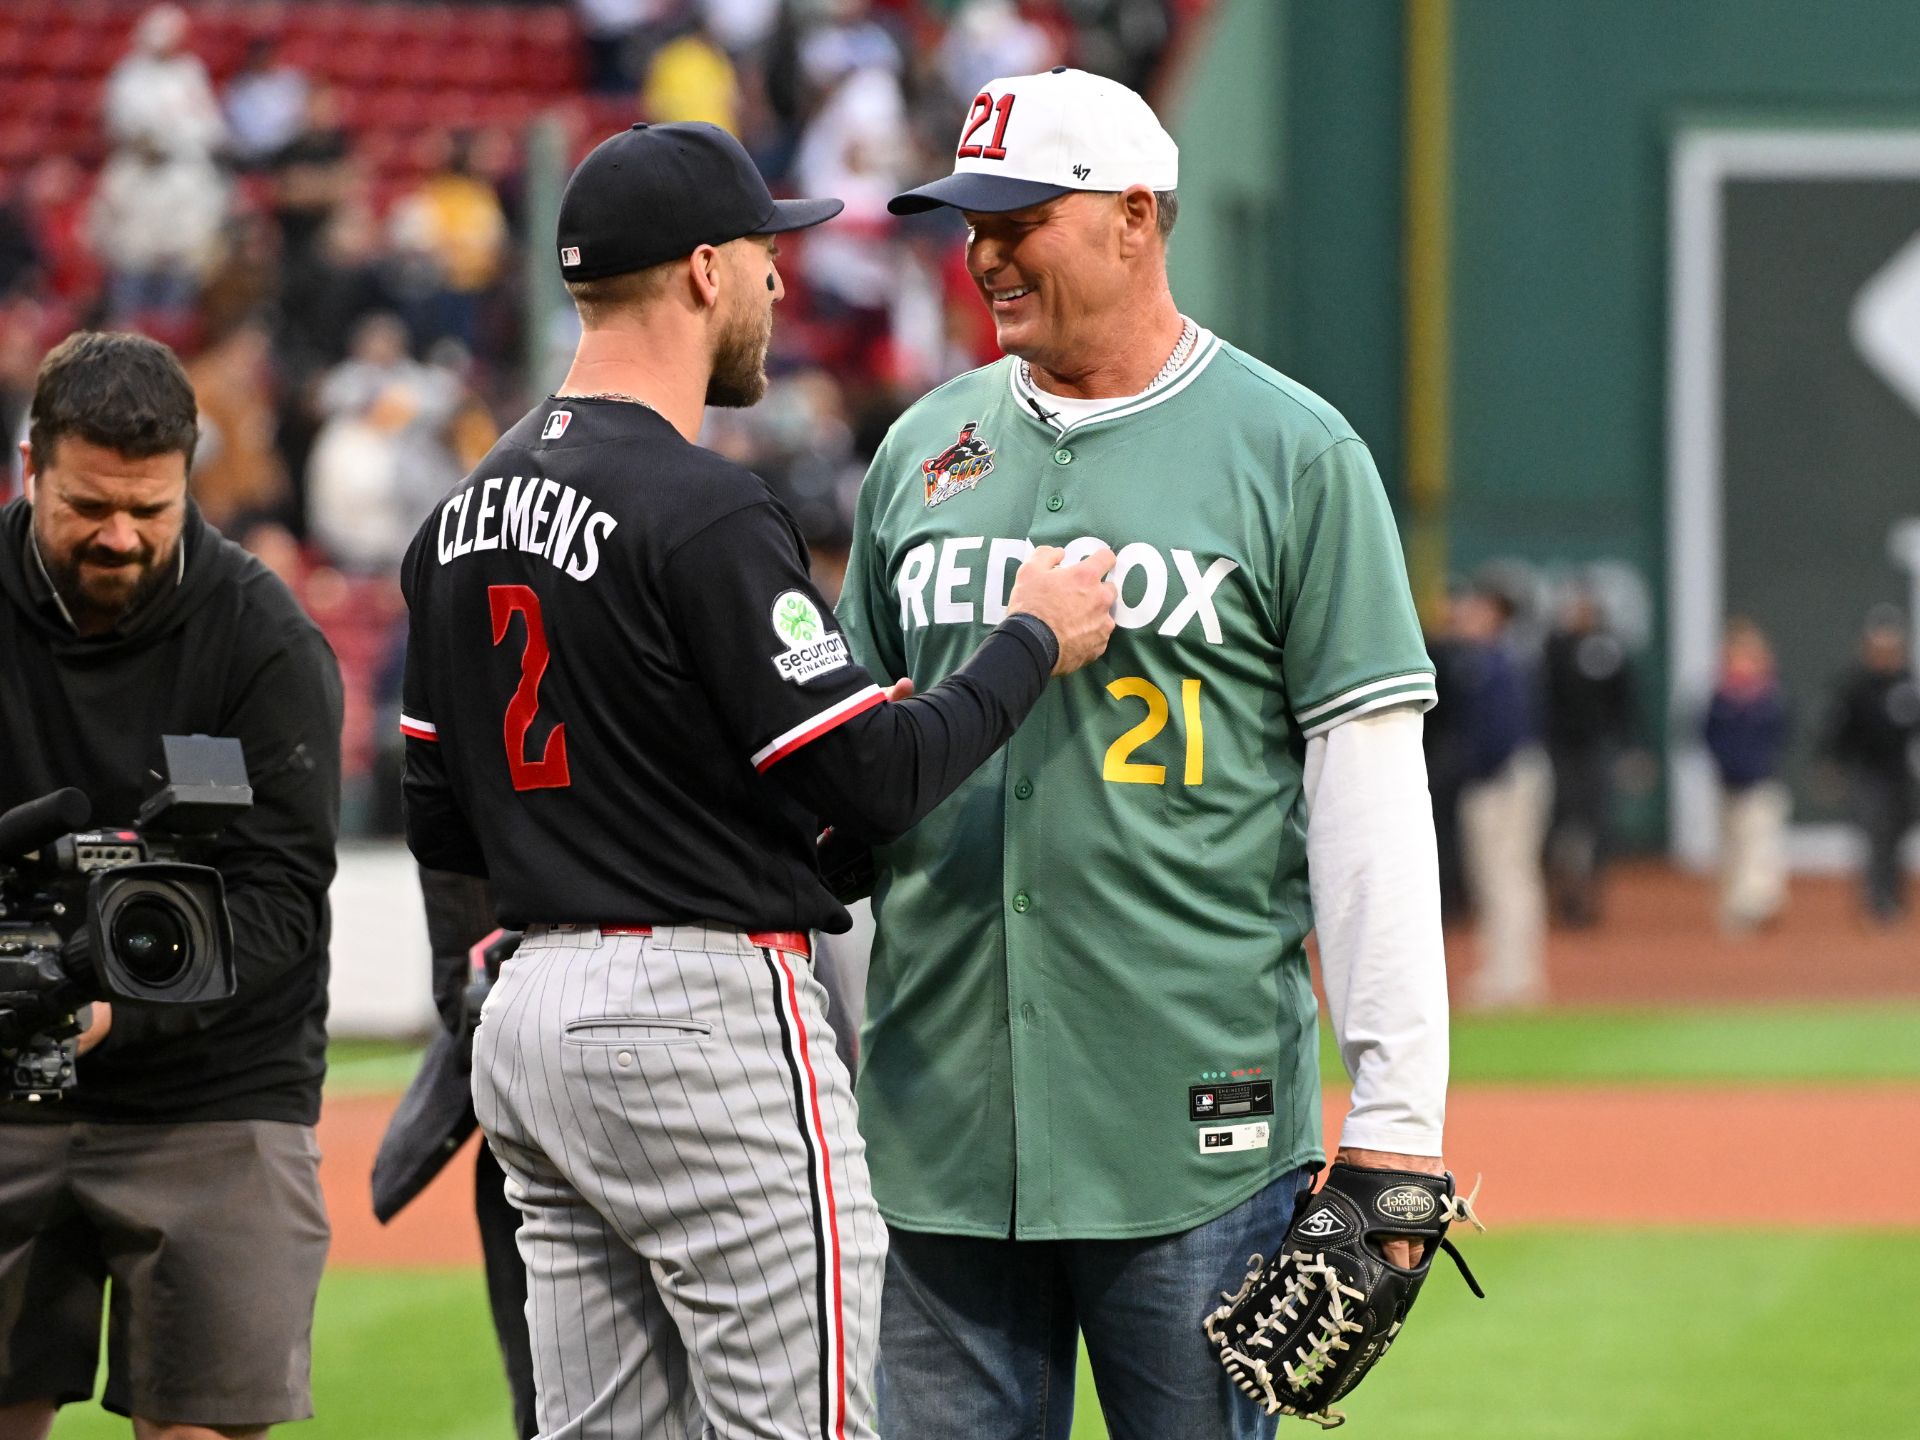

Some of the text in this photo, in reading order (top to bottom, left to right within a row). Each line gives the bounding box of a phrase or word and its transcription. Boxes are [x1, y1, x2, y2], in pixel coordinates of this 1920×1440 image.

[958, 92, 1016, 160] 21
[437, 476, 618, 582] CLEMENS
[898, 536, 1035, 631] RED
[488, 585, 571, 791] 2
[780, 637, 844, 671] securian
[797, 654, 844, 676] FINANCIAL
[1103, 676, 1204, 785] 21
[1382, 1191, 1430, 1211] Slugger
